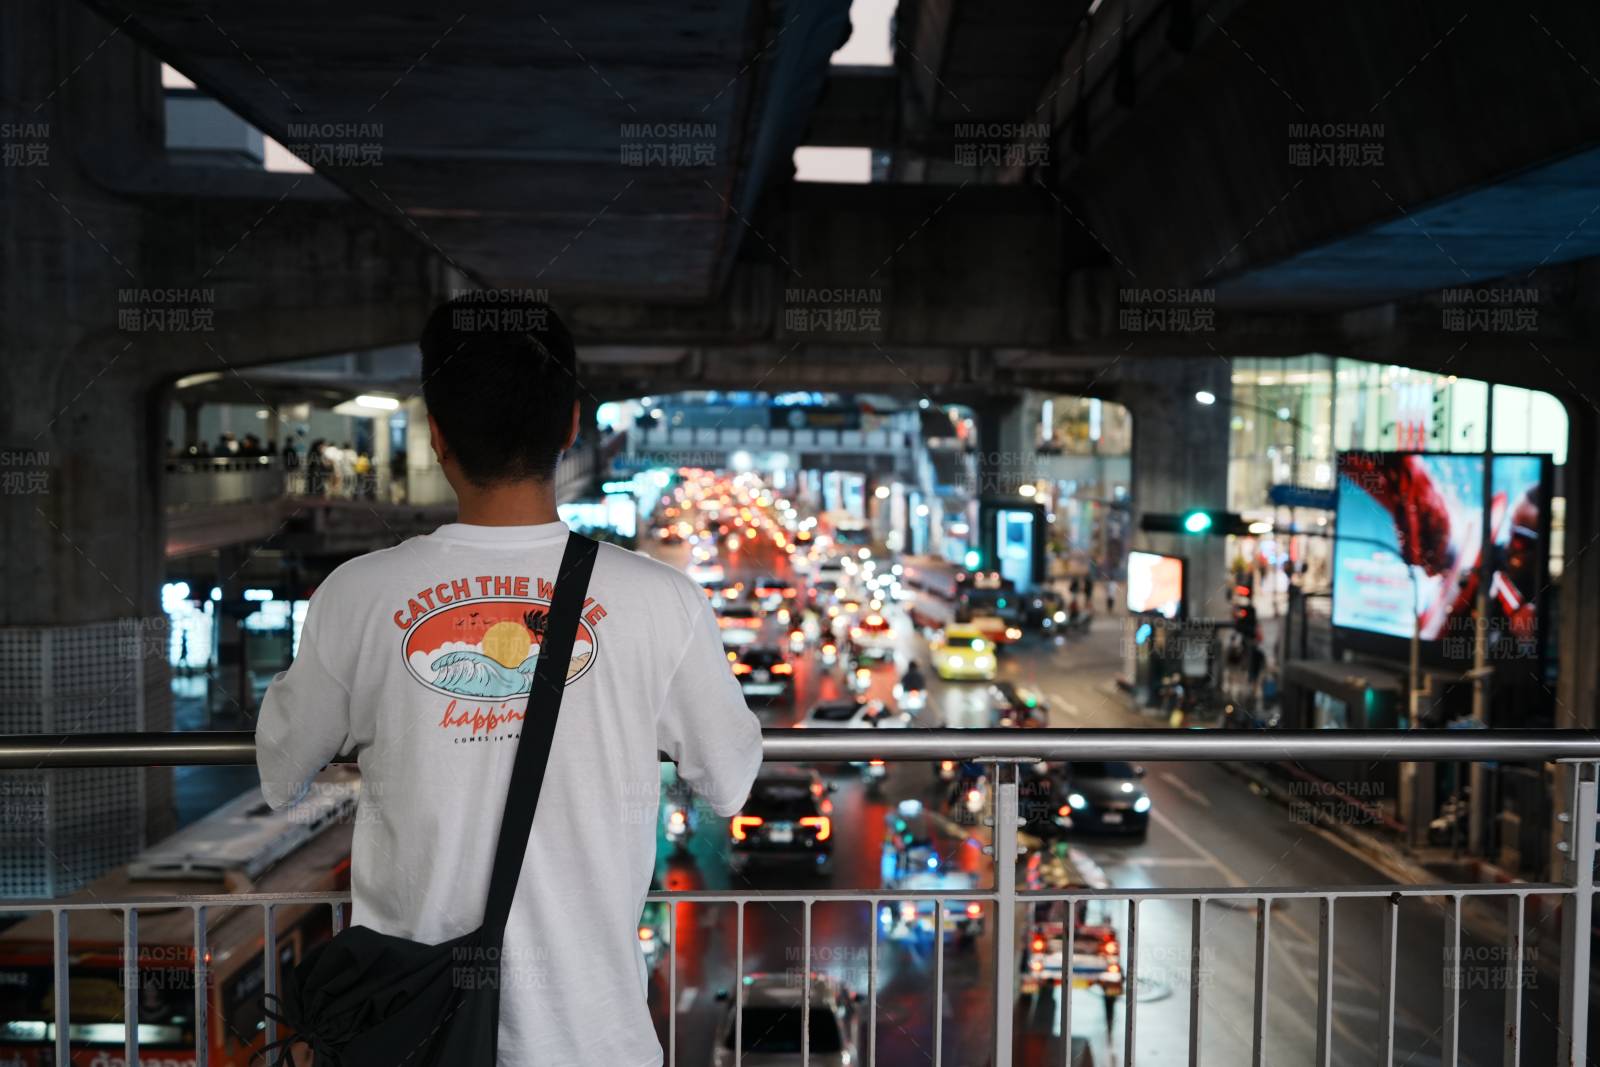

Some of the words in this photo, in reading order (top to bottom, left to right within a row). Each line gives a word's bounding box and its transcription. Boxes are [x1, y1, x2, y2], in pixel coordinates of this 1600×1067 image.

[394, 578, 472, 630] CATCH
[476, 576, 530, 596] THE
[537, 577, 607, 627] WE
[439, 699, 527, 736] happin
[454, 735, 489, 744] COMES
[507, 732, 521, 740] WA
